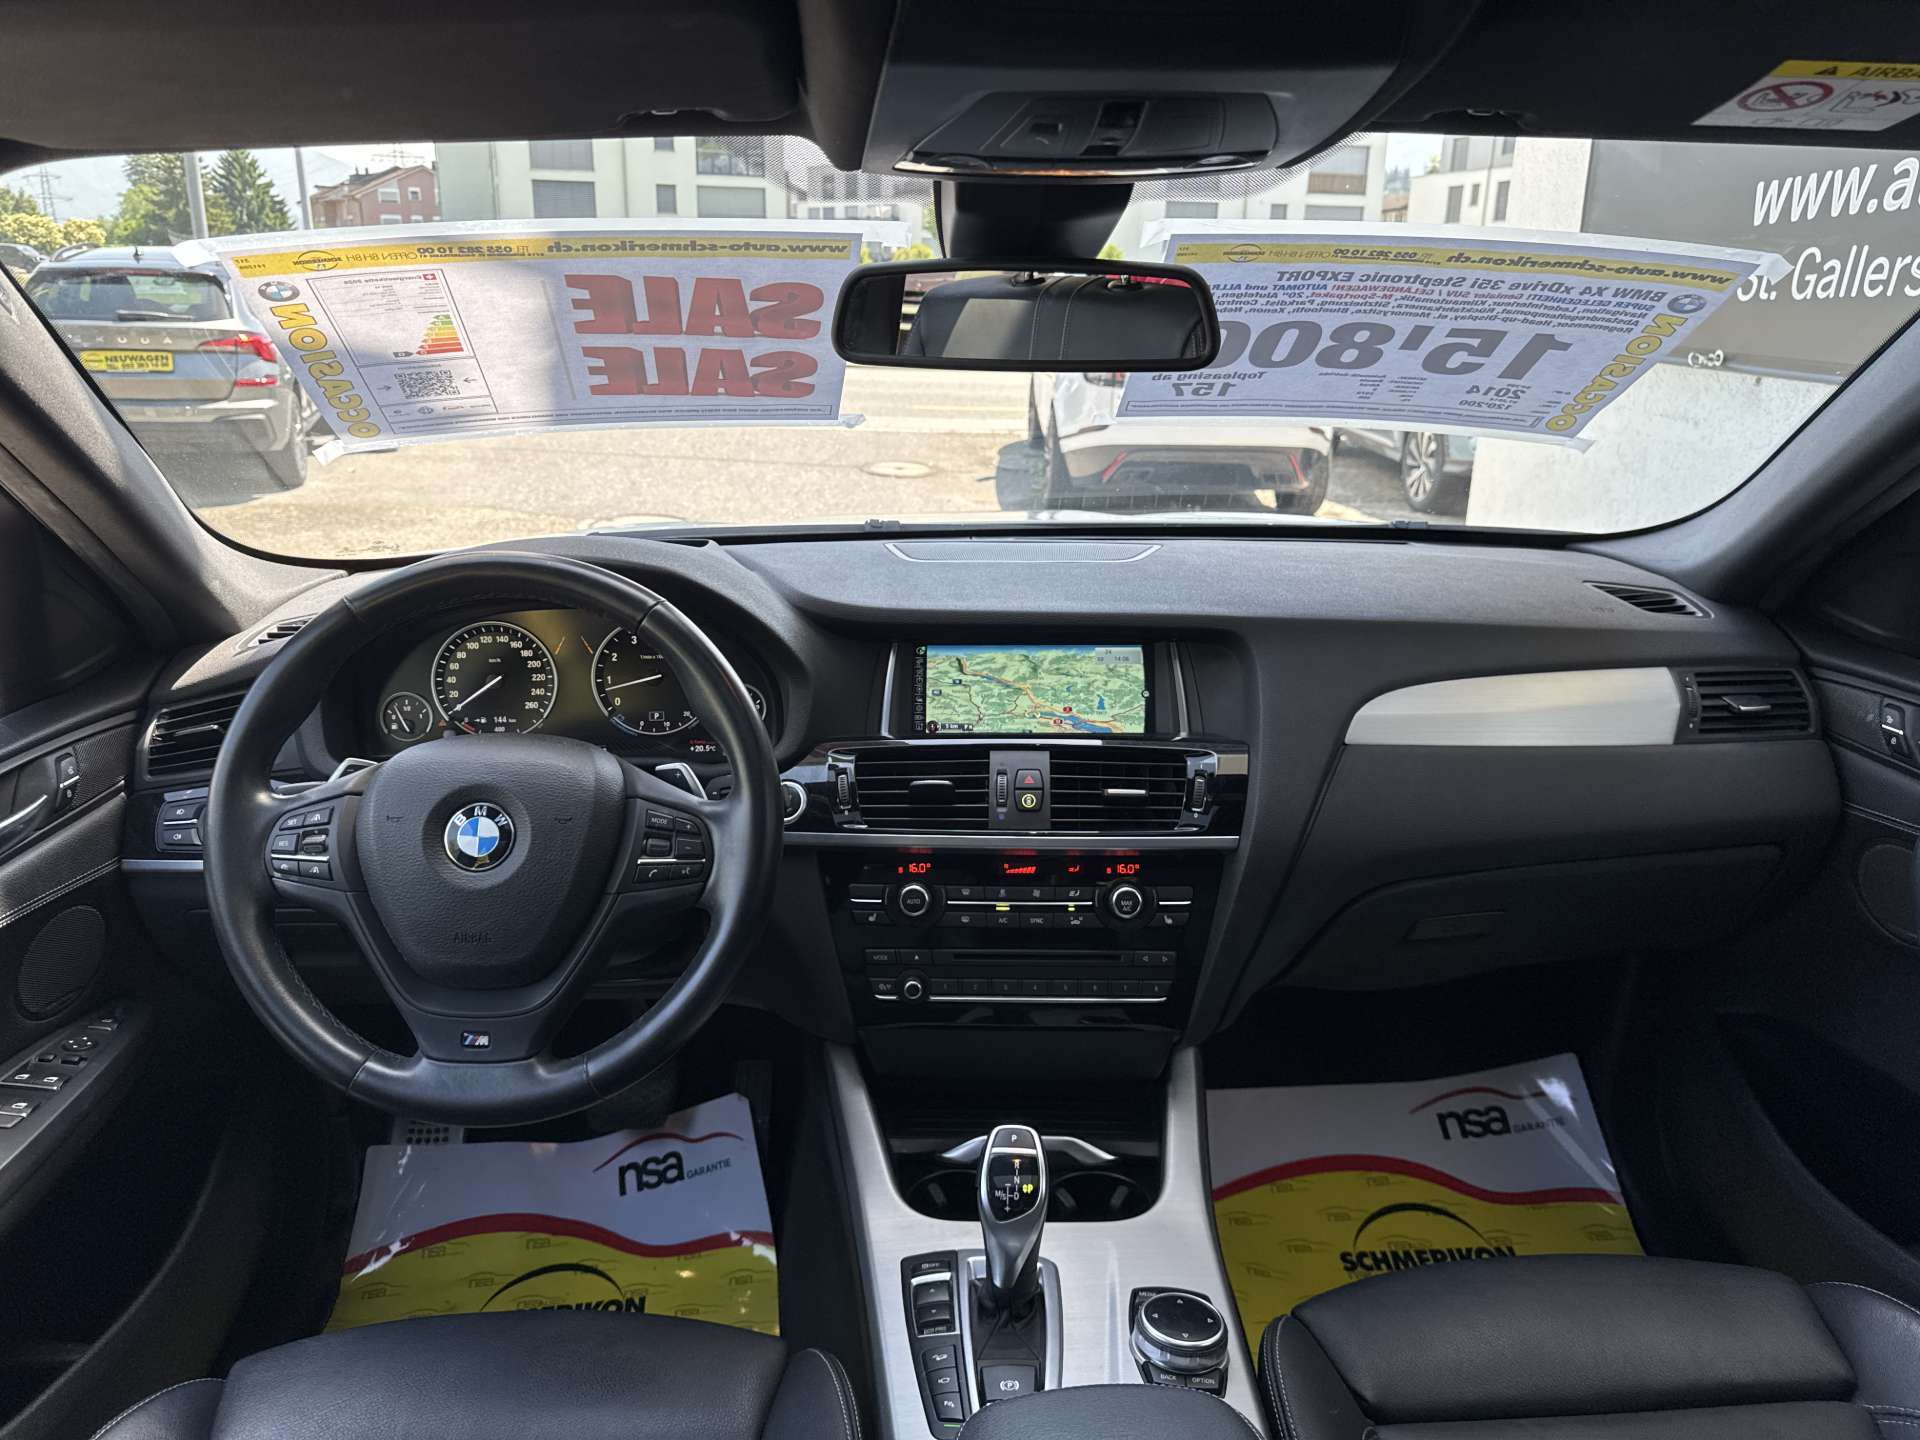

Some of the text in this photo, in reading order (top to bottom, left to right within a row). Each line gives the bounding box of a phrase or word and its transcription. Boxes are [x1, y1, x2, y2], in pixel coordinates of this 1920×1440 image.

[1848, 66, 1920, 79] AIRB
[1753, 156, 1920, 227] www.a
[104, 354, 170, 364] NEUWAGEN
[479, 635, 493, 644] 120
[495, 635, 509, 644] 140
[630, 635, 638, 645] 3
[466, 642, 480, 651] 100
[509, 640, 523, 650] 160
[456, 651, 467, 660] 80
[519, 650, 534, 659] 180
[611, 653, 619, 663] 2
[449, 662, 460, 671] 60
[527, 660, 542, 669] 200
[446, 676, 457, 684] 40
[531, 673, 546, 682] 220
[606, 676, 613, 685] 1
[448, 690, 460, 699] 20
[530, 688, 545, 697] 240
[614, 697, 621, 706] 0
[524, 702, 539, 711] 260
[453, 805, 509, 828] BMW
[650, 817, 668, 825] MODE
[1435, 1106, 1513, 1141] nsa
[1011, 1134, 1018, 1143] P
[618, 1149, 732, 1197] nsa GARANTIE
[1013, 1192, 1020, 1201] D
[1160, 1373, 1177, 1382] BACK
[1191, 1377, 1216, 1386] OPTION
